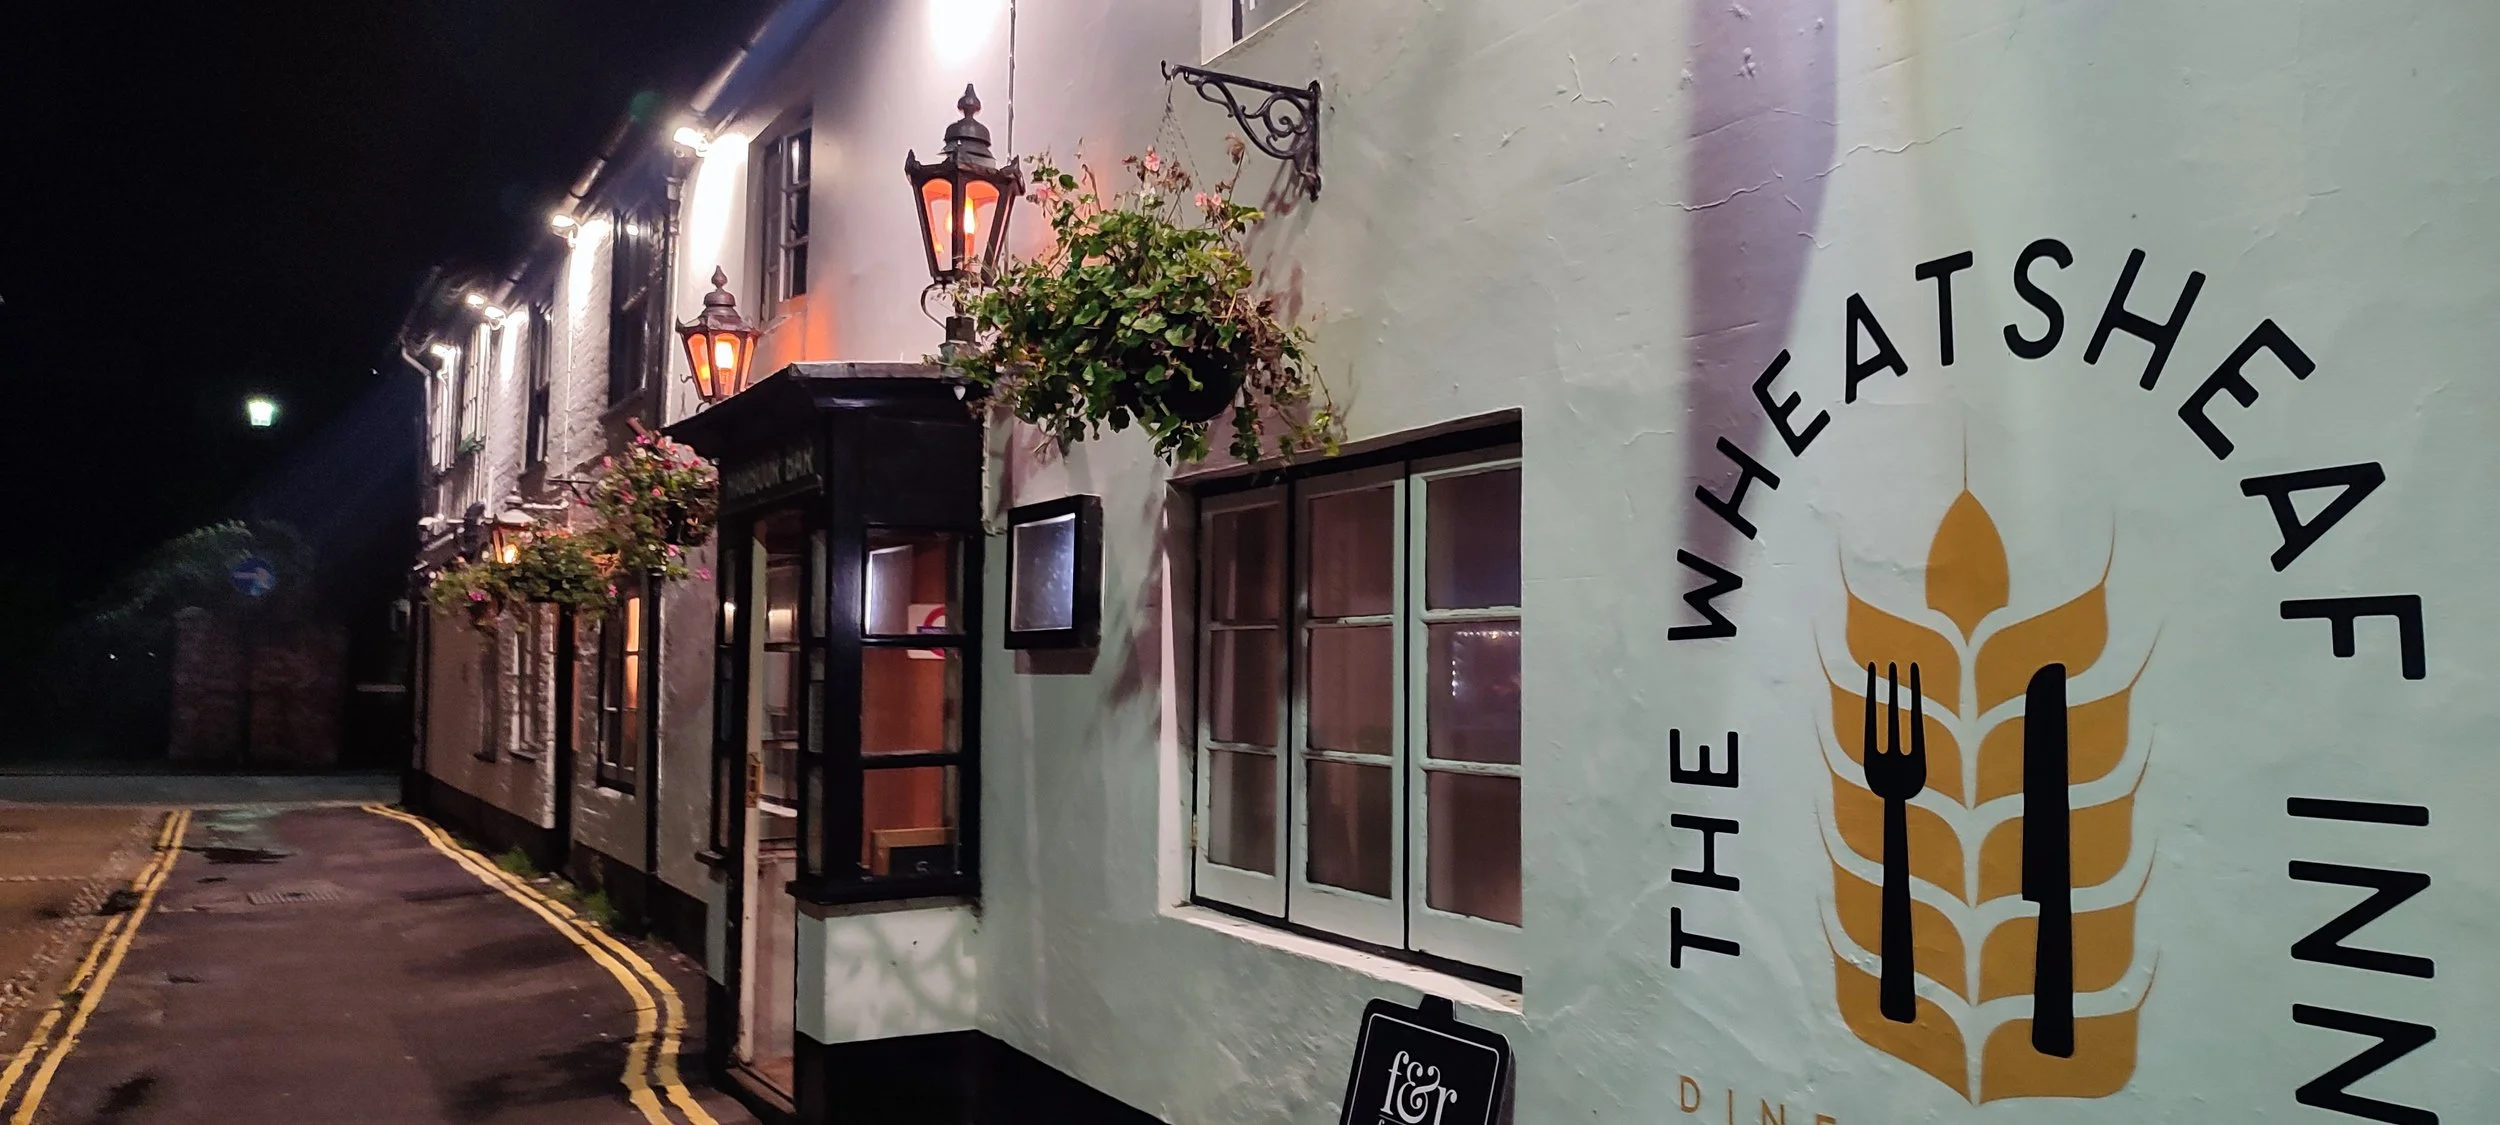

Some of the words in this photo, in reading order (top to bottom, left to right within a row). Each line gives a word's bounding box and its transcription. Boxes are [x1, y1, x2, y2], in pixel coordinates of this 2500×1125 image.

[1667, 238, 2426, 681] WHEATSHEAF
[1669, 728, 1741, 969] THE
[2286, 796, 2440, 1125] INN
[1380, 1050, 1458, 1125] f&r
